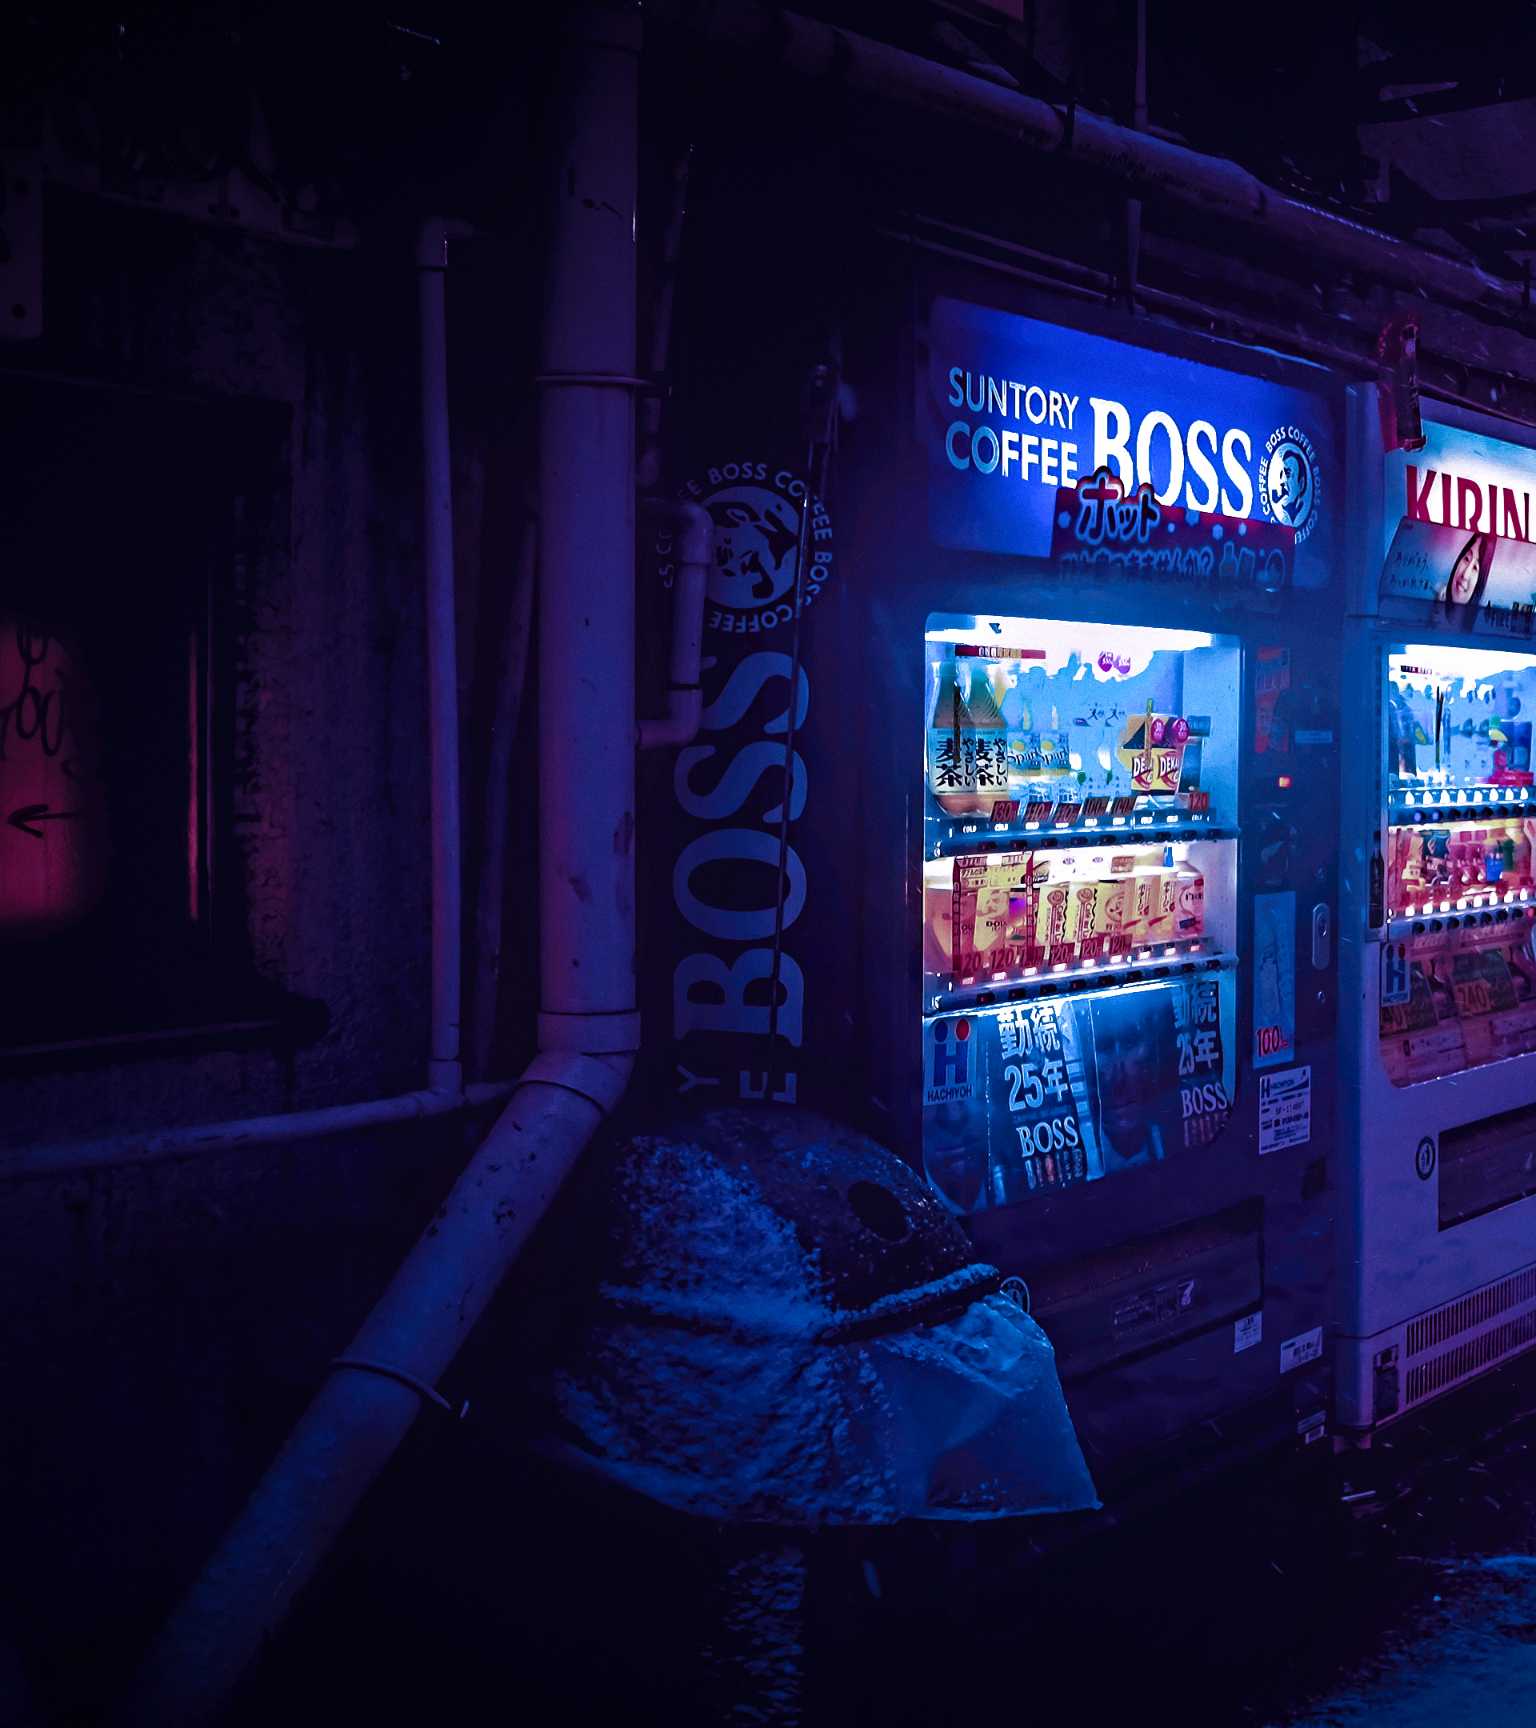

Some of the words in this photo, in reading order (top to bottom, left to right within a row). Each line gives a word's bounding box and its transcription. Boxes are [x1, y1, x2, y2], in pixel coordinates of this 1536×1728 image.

[948, 366, 1079, 431] SUNTORY
[945, 420, 1078, 489] COFFEE
[1089, 397, 1253, 519] BOSS
[1265, 425, 1286, 454] BOSS
[705, 461, 768, 486] BOSS
[1074, 475, 1161, 544] ホット
[1406, 463, 1530, 543] KIRIN
[709, 603, 793, 634] COFFEE
[961, 738, 976, 787] やさしい
[993, 737, 1007, 786] やさしい
[673, 650, 810, 1047] BOSS
[991, 948, 1014, 970] 120
[997, 1003, 1061, 1061] 勤続
[1176, 1029, 1220, 1076] 25年
[1257, 1026, 1281, 1057] 100
[927, 1083, 974, 1102] HACHIYOH
[1004, 1057, 1068, 1113] 25年
[1180, 1081, 1229, 1119] BOSS
[1016, 1115, 1080, 1158] BOSS
